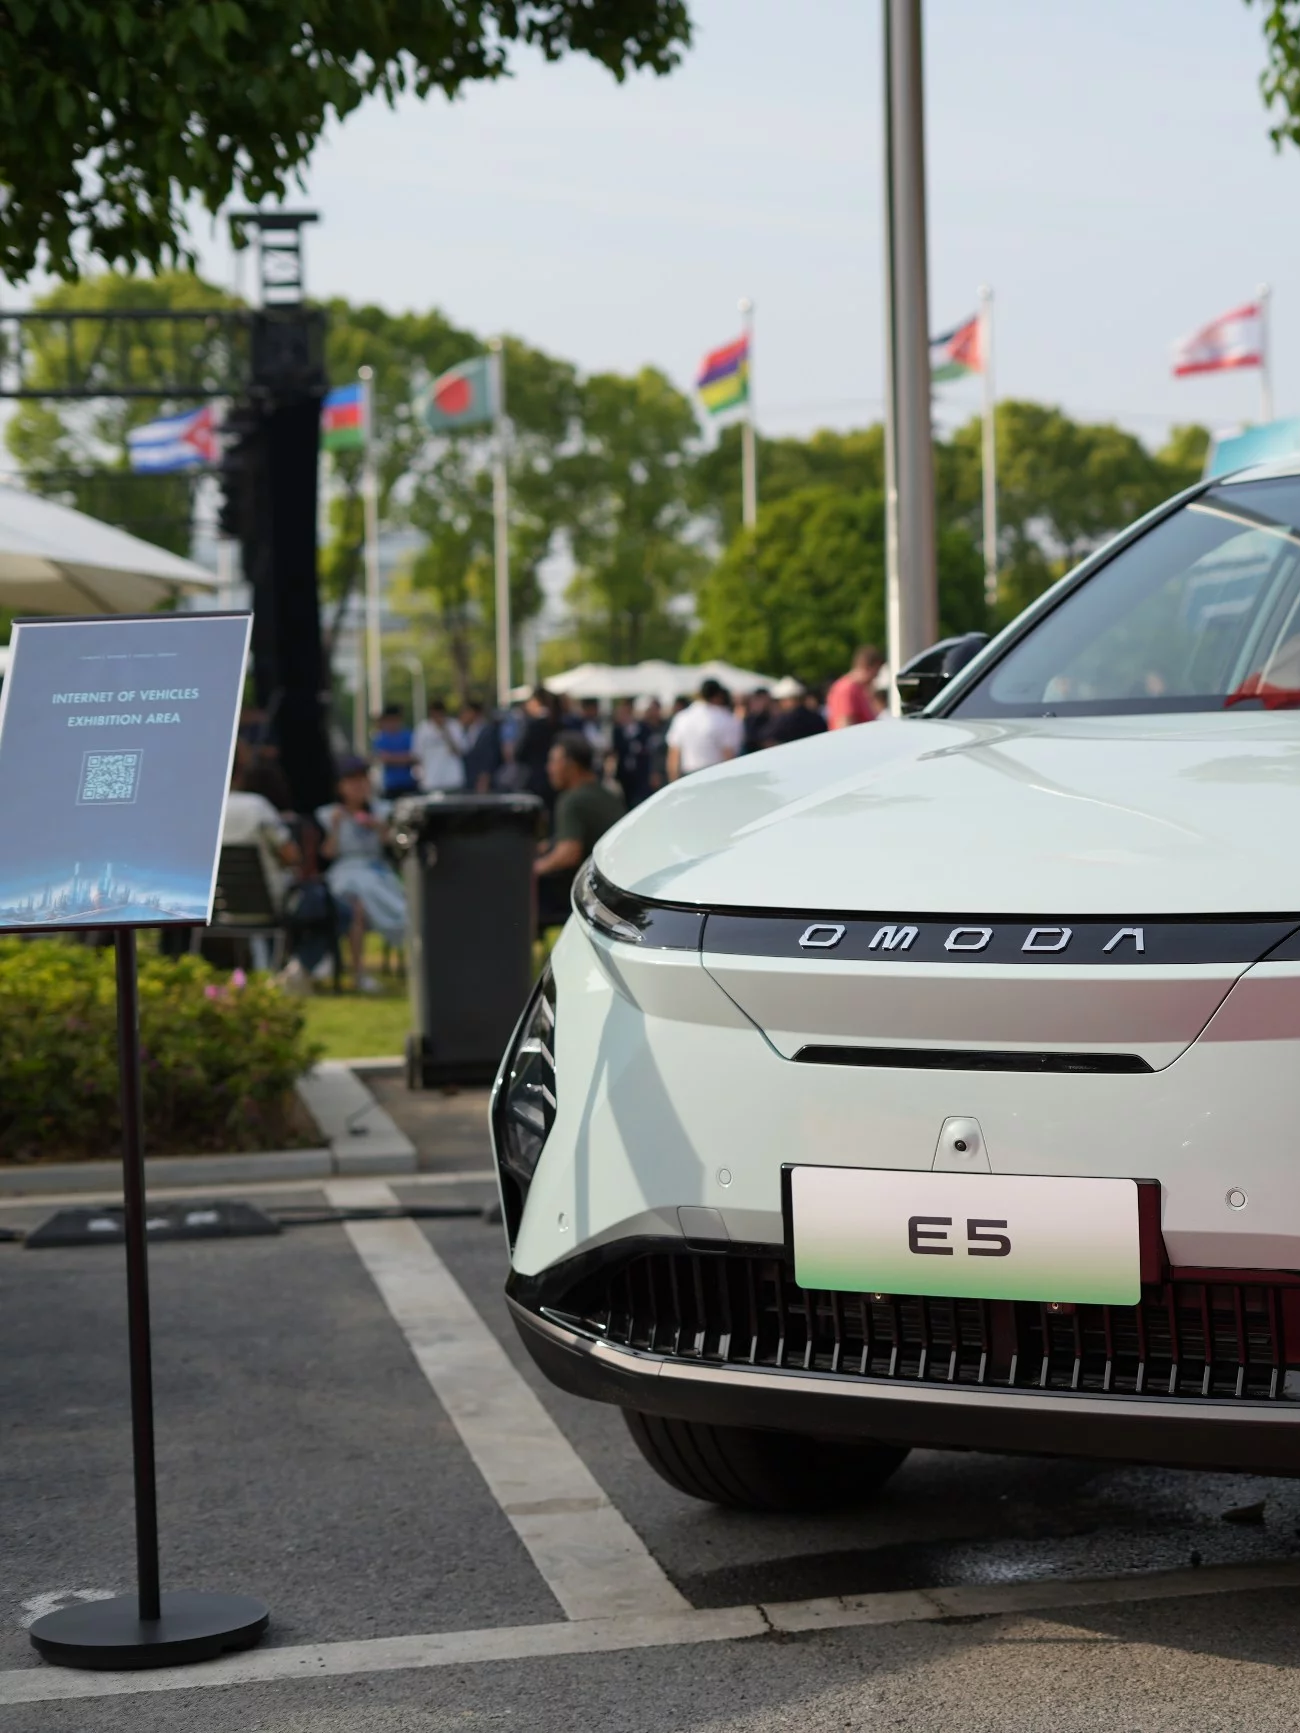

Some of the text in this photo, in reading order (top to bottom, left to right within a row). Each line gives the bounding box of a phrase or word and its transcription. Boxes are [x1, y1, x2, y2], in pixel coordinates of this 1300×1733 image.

[52, 688, 199, 704] INTERNET OF VEHICLES
[67, 713, 181, 727] EXHIBITION AREA
[798, 923, 1146, 953] OMODA
[907, 1215, 1012, 1257] E5
